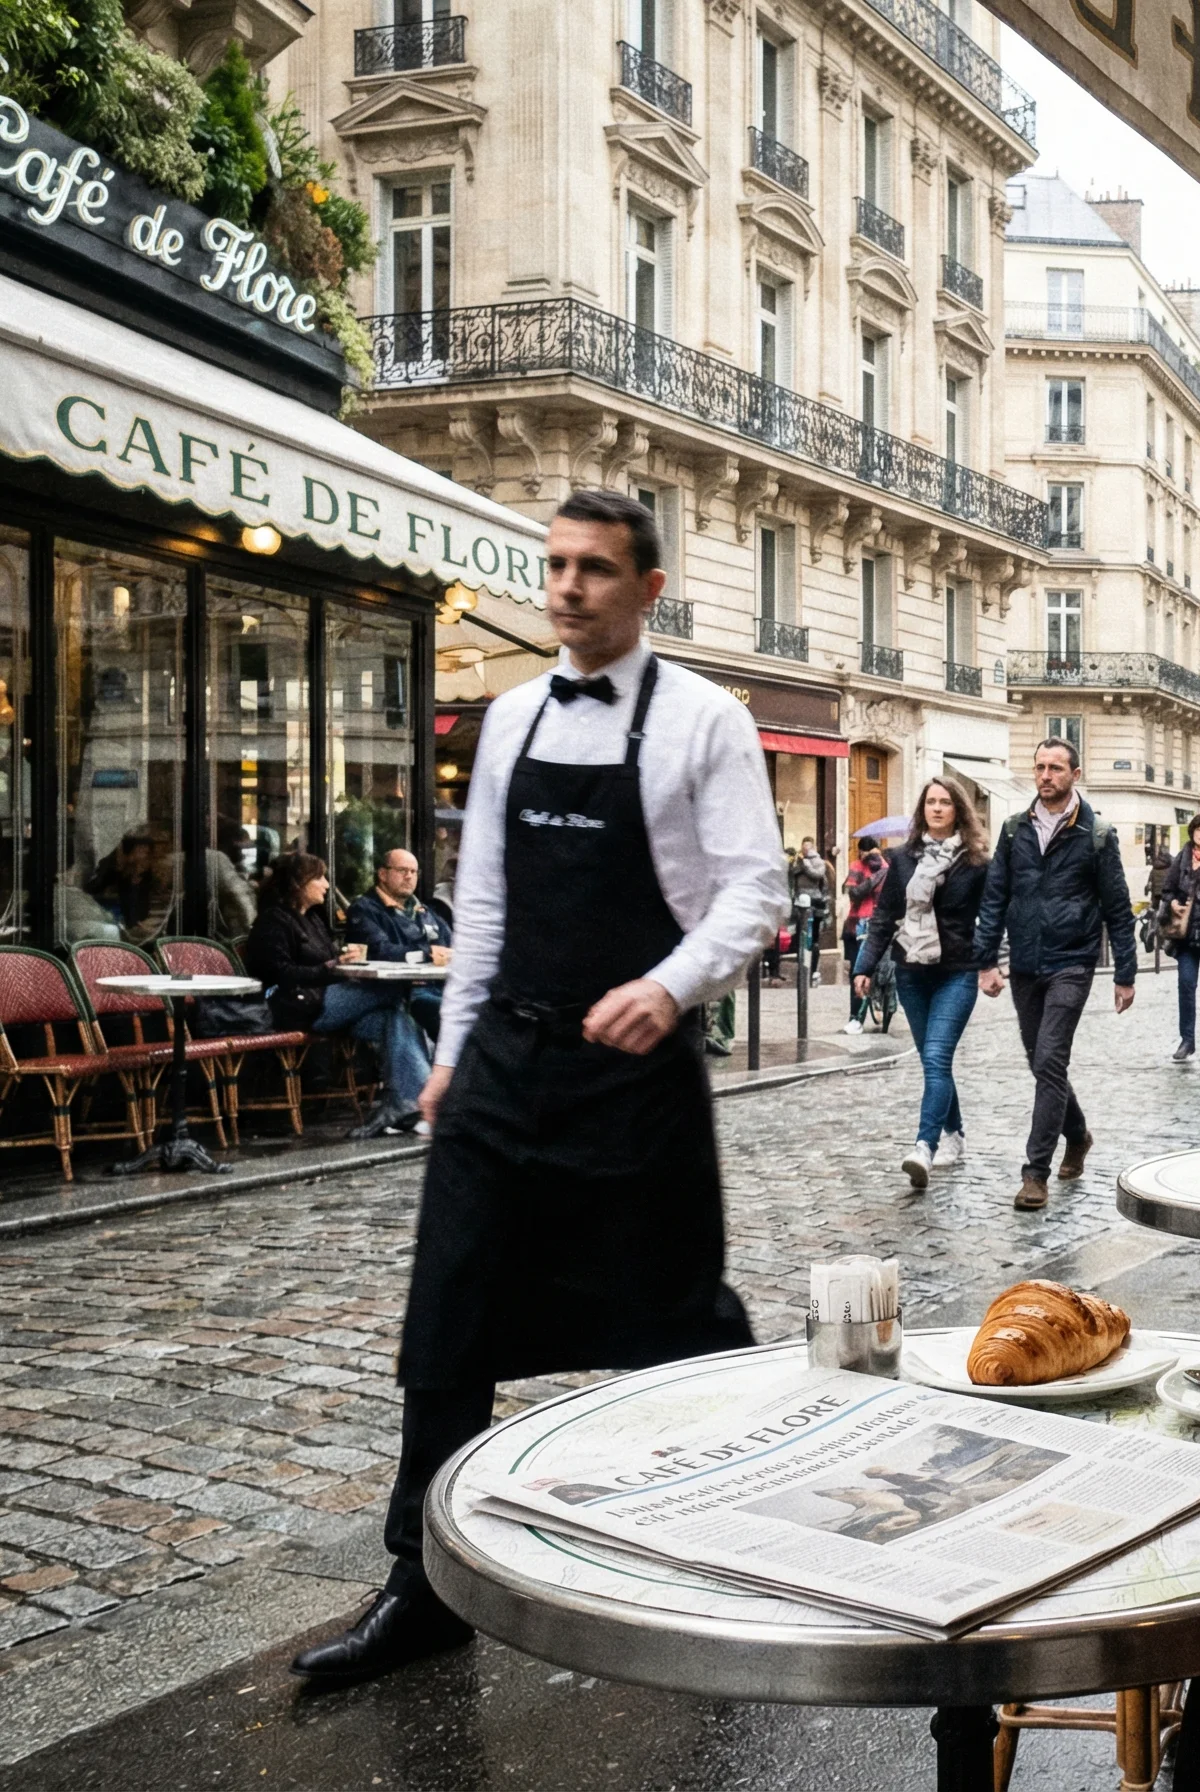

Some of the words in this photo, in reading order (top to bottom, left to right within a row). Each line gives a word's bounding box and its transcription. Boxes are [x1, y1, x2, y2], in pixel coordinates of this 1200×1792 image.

[129, 205, 184, 266] de
[199, 217, 317, 334] Flore
[56, 395, 270, 507] CAFÉ
[303, 475, 381, 541] DE
[614, 1457, 709, 1487] CAFÉ
[700, 1442, 756, 1461] DE
[743, 1394, 850, 1444] FLORE
